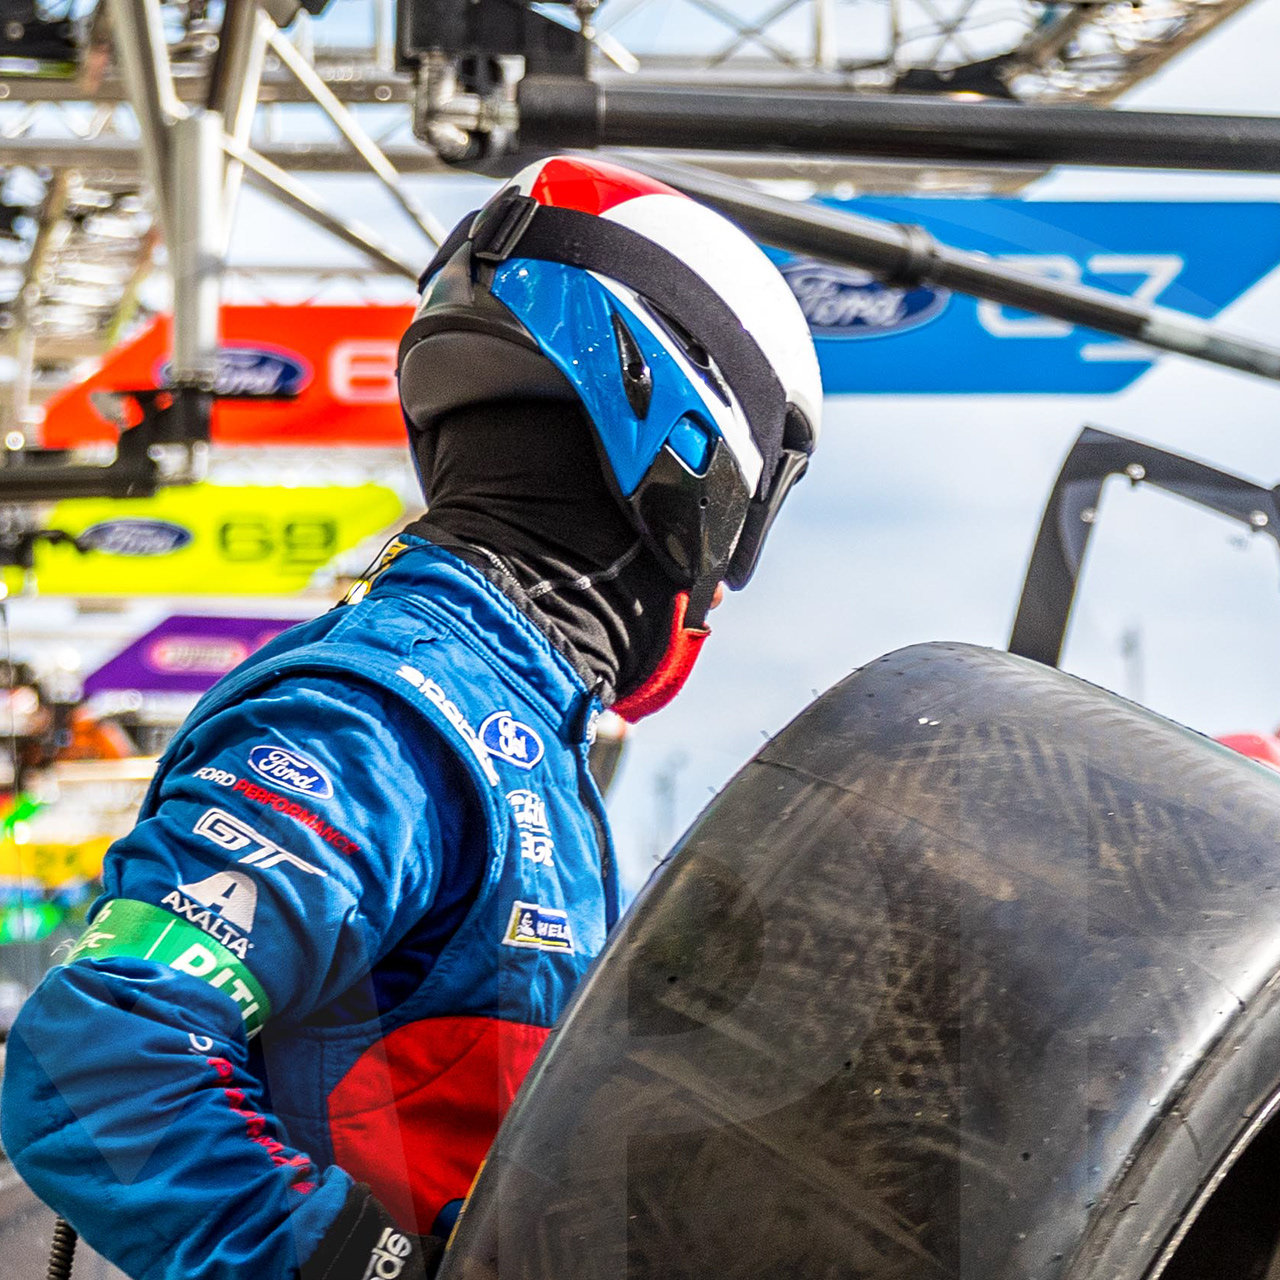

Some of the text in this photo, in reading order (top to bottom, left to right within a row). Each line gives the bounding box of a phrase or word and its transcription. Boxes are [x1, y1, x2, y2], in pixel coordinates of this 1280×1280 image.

[328, 342, 403, 404] 6
[218, 518, 337, 566] 69
[258, 751, 320, 790] Ford
[192, 766, 361, 856] FORD PERFORMANCE
[192, 807, 328, 877] GT
[160, 889, 255, 960] AXALTA
[168, 941, 264, 1041] PITL
